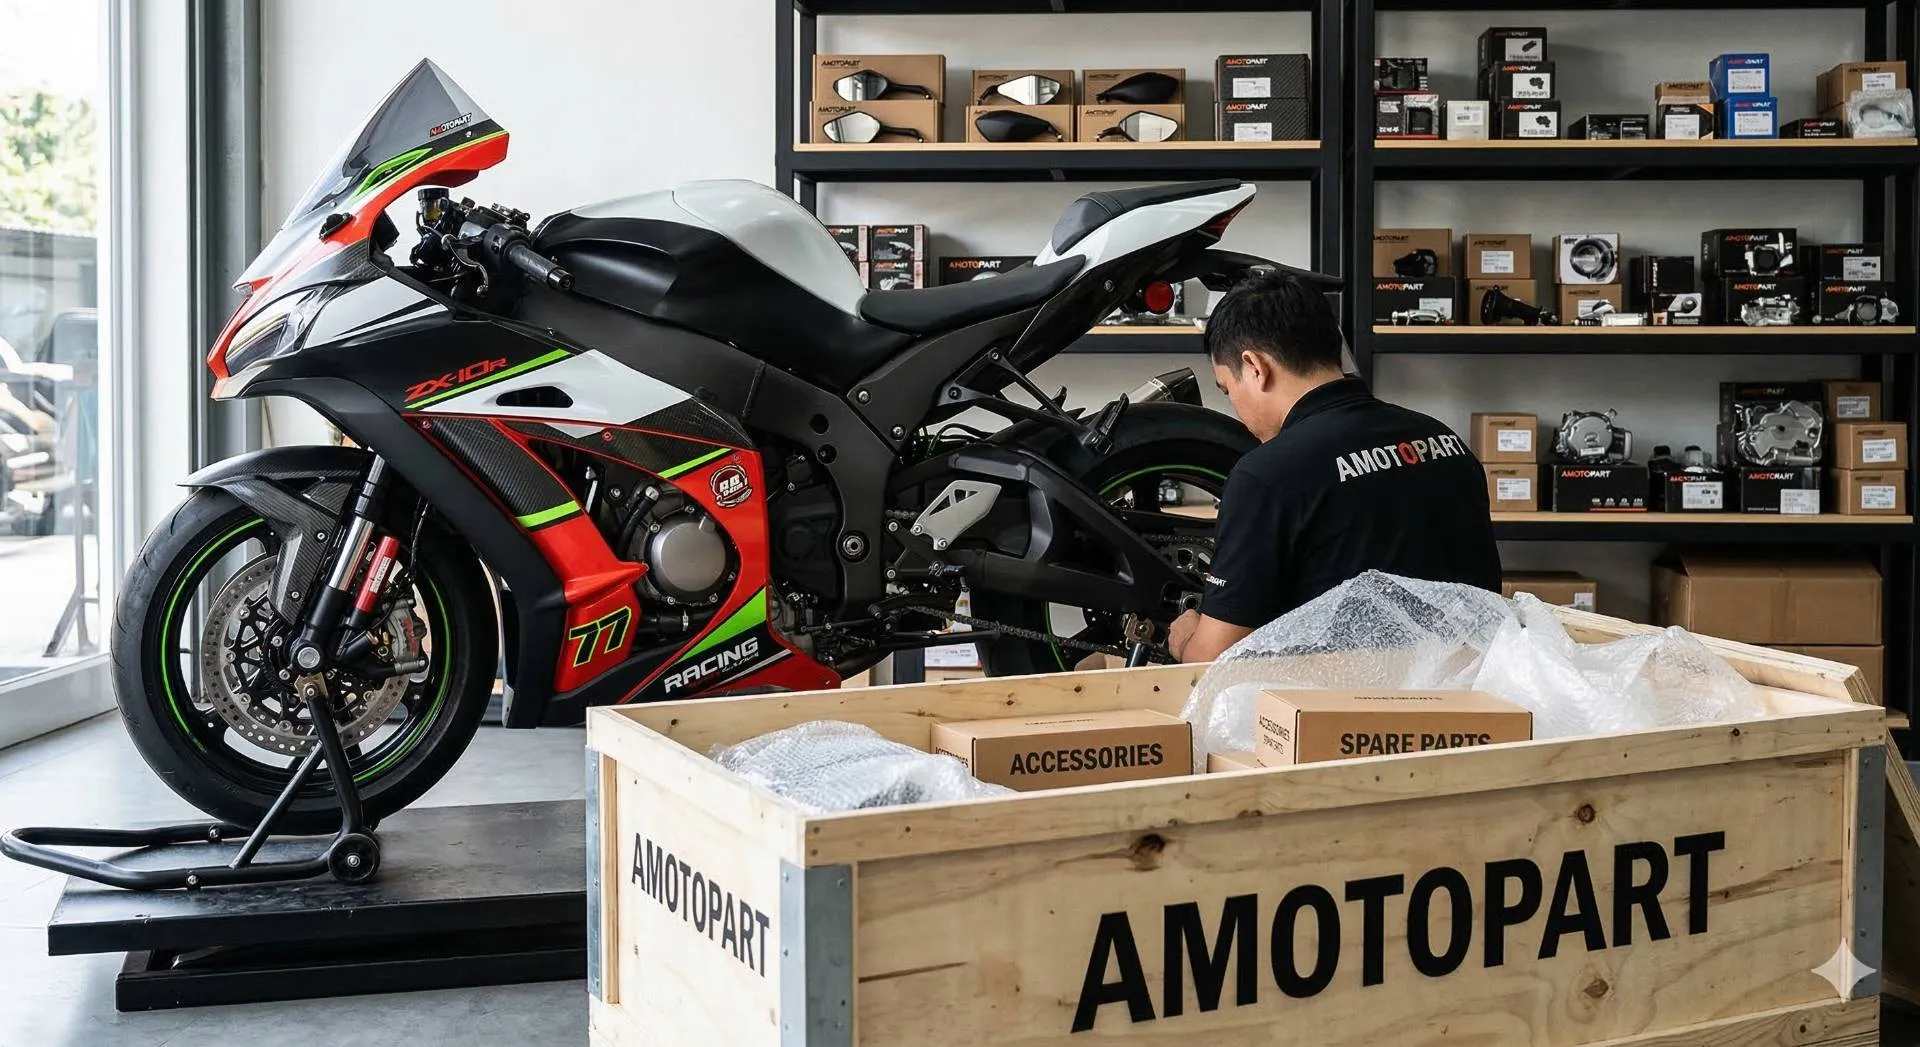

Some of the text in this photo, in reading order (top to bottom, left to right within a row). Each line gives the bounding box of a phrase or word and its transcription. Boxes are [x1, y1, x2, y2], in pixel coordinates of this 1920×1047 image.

[404, 357, 508, 402] ZX-10R
[1336, 435, 1466, 482] AMOTOPART
[1561, 470, 1611, 478] AMOTOPART
[568, 605, 632, 668] 77
[664, 636, 759, 694] RACING
[1009, 743, 1164, 776] ACCESSORIES
[1340, 733, 1415, 755] SPARE
[631, 832, 770, 977] AMOTOPART
[1069, 830, 1726, 1033] AMOTOPART
